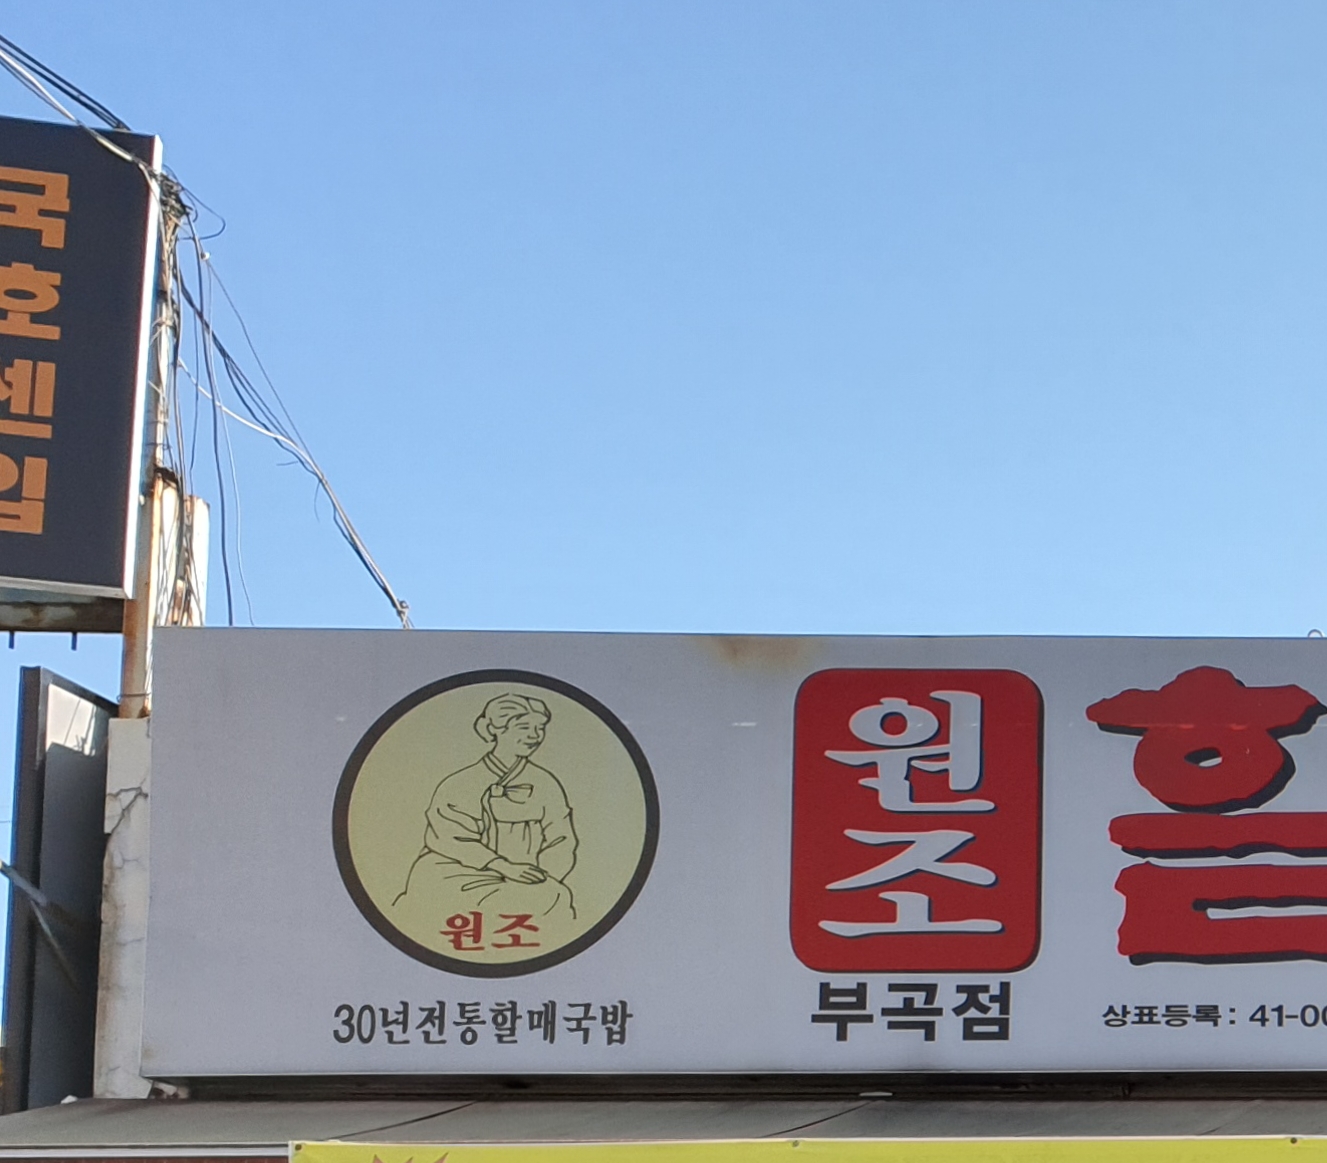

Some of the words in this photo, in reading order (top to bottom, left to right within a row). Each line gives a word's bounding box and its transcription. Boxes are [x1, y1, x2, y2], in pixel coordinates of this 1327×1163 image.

[817, 690, 1005, 938] 원조
[440, 910, 541, 951] 원조
[333, 1000, 634, 1046] 30년전통할매국밥
[810, 981, 1012, 1042] 부곡점
